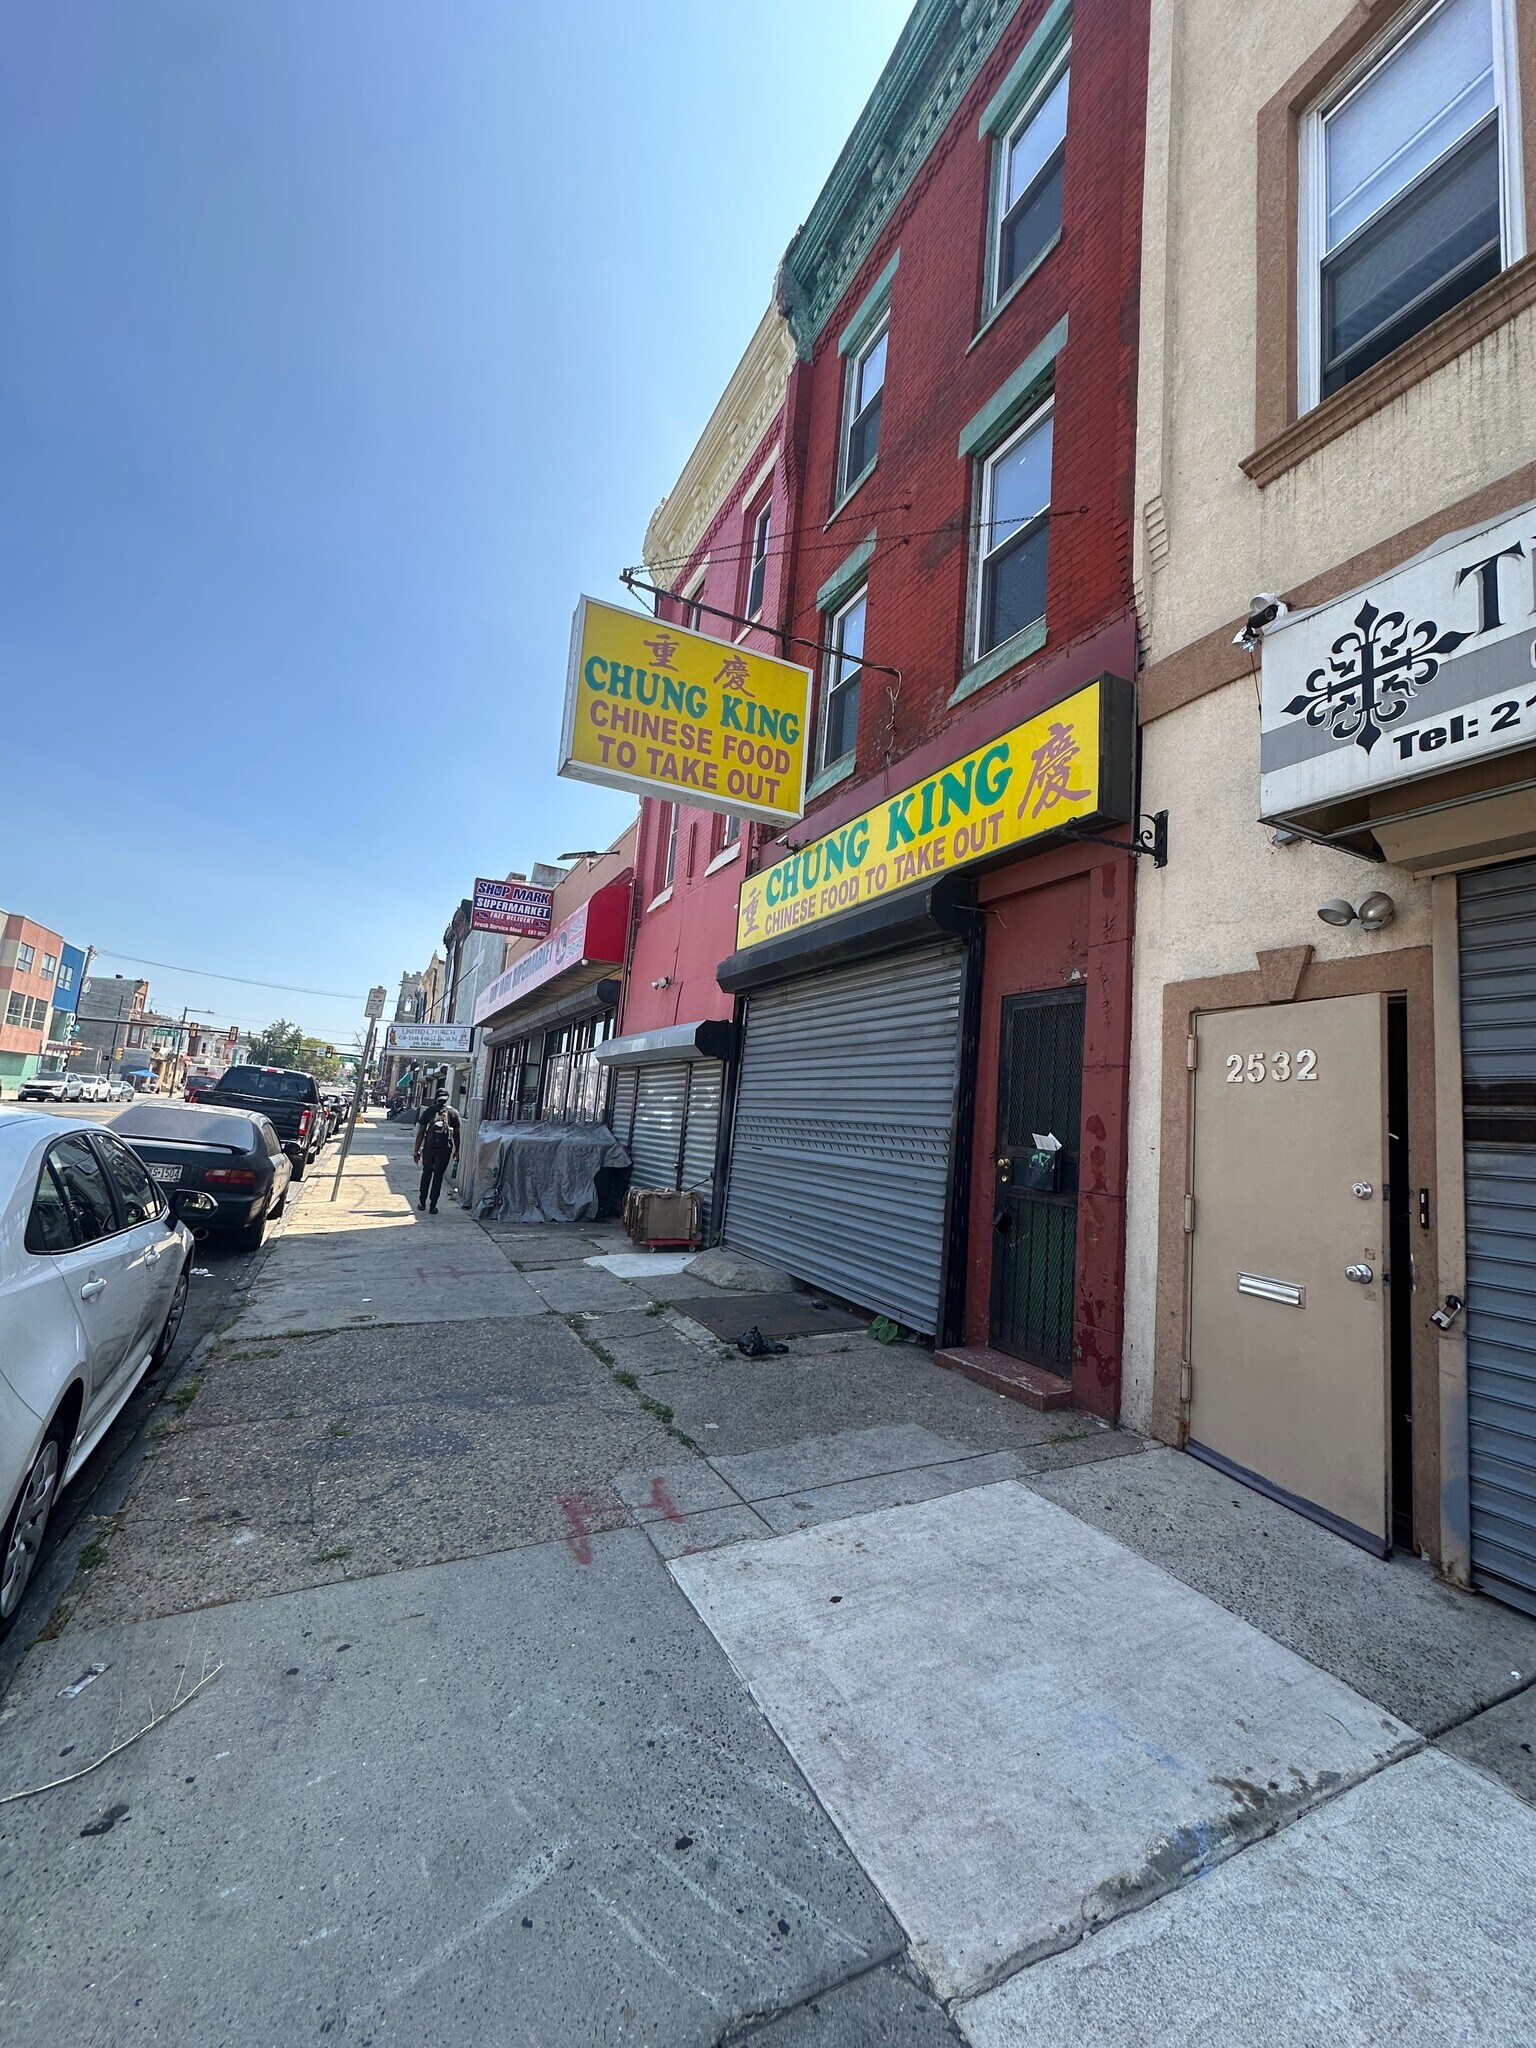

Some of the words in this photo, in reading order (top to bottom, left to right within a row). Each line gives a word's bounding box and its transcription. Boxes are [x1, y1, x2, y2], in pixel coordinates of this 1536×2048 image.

[1454, 540, 1536, 637] T
[643, 633, 679, 672] 重
[713, 654, 755, 698] 慶
[584, 655, 708, 719] CHUNG
[720, 693, 799, 745] KING
[1393, 713, 1478, 761] Tel:
[1490, 693, 1536, 733] 2
[590, 699, 713, 755] CHINESE
[722, 734, 790, 775] FOOD
[598, 734, 637, 769] TO
[646, 746, 718, 790] TAKE
[727, 769, 780, 803] OUT
[1017, 722, 1092, 820] 慶
[765, 818, 870, 907] CHUNG
[886, 741, 1013, 852] KING
[477, 882, 511, 897] SHOP
[512, 888, 551, 905] MARK
[765, 893, 816, 936] CHINESE
[819, 874, 860, 915] FOOD
[865, 862, 888, 893] TO
[894, 835, 945, 883] TAKE
[952, 810, 1004, 864] OUT
[476, 898, 549, 917] SUPERMARKET
[490, 912, 505, 920] FREE
[506, 915, 535, 924] DELIVERY
[742, 886, 762, 938] 重
[426, 1028, 456, 1036] CHURCH
[1226, 1048, 1318, 1083] 2532
